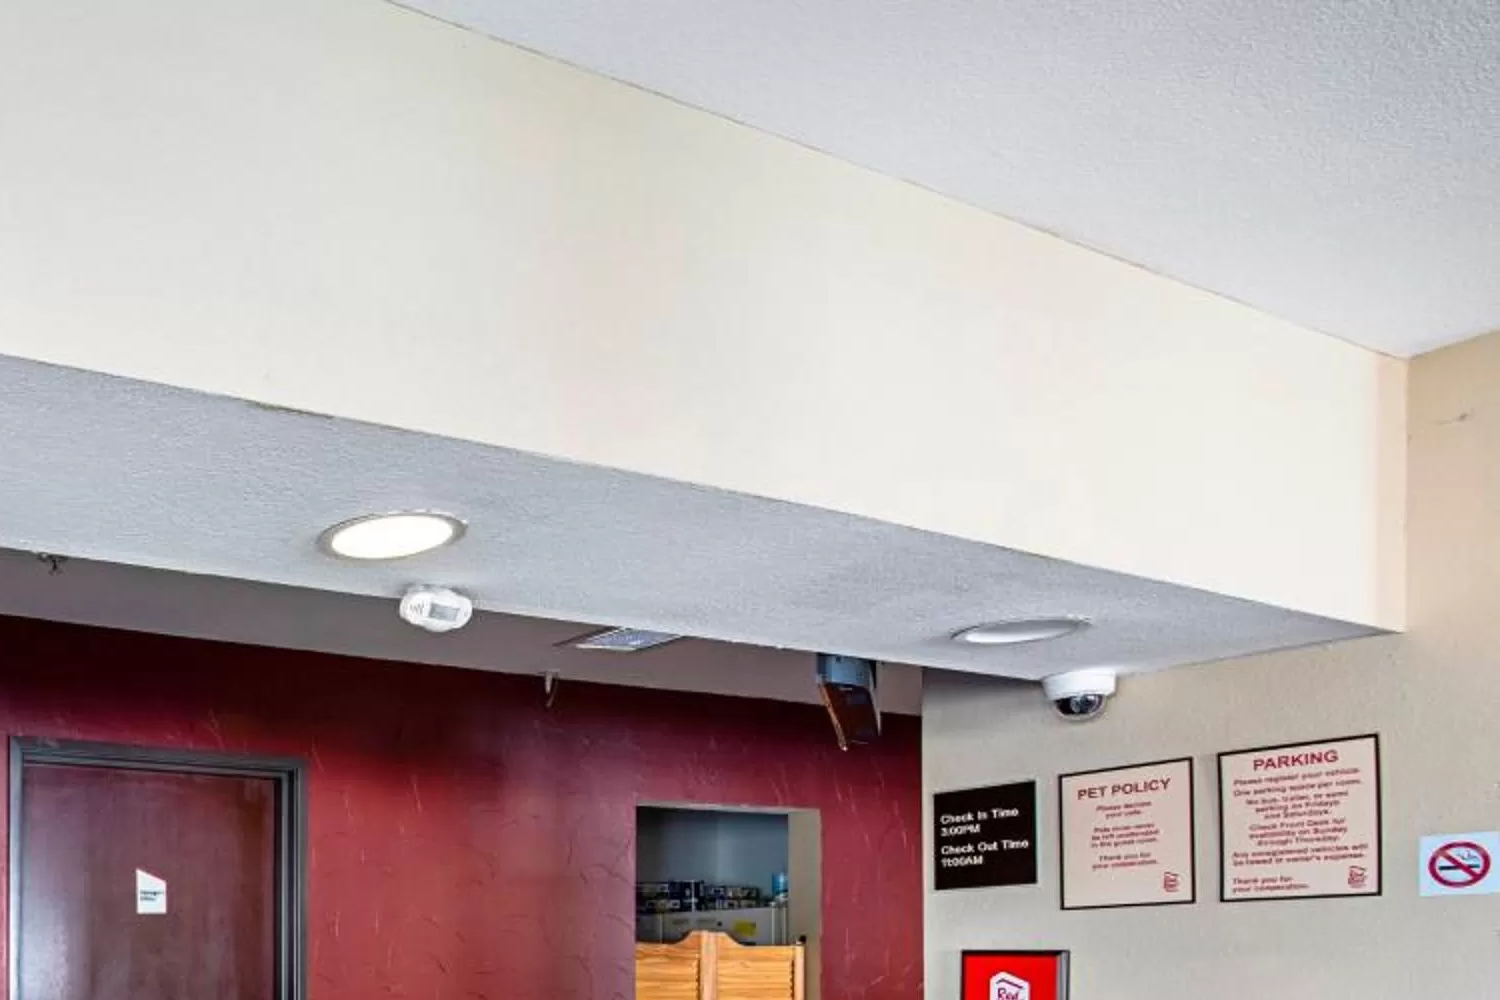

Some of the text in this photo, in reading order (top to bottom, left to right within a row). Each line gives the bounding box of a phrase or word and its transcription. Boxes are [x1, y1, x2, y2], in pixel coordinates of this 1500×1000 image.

[1253, 750, 1339, 771] PARKING
[1078, 778, 1171, 800] PET POLICY
[940, 808, 1019, 824] Check In Time
[941, 824, 980, 836] 3:00PM
[941, 840, 1029, 855] Check Out Time
[998, 987, 1019, 1000] Red
